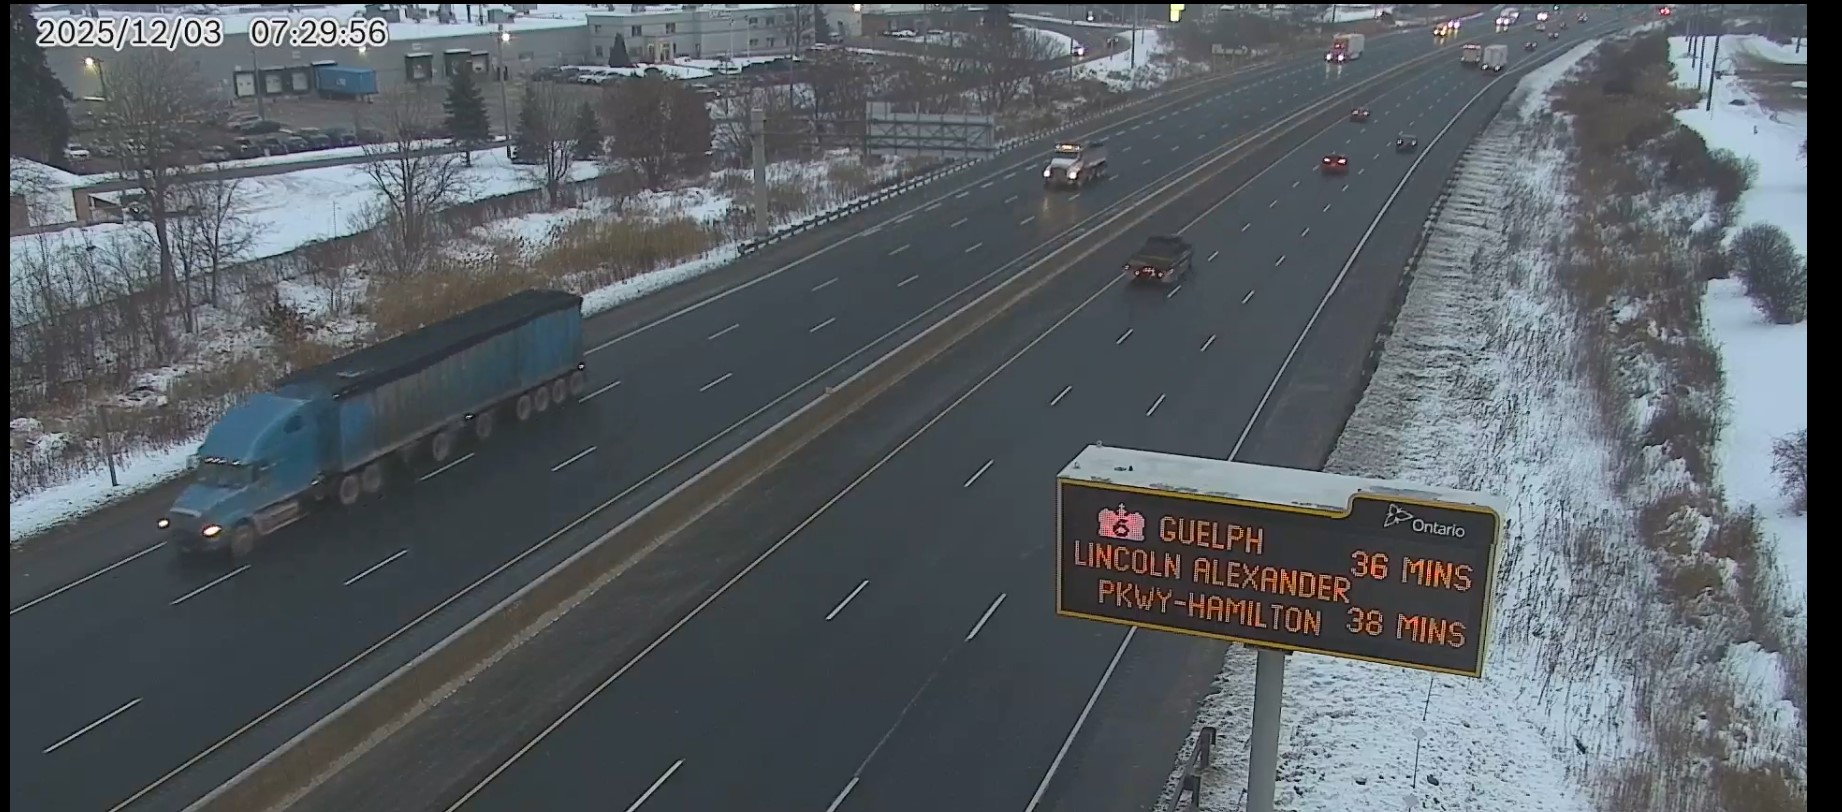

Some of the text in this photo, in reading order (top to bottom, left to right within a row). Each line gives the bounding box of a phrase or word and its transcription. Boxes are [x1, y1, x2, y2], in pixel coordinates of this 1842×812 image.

[1112, 519, 1129, 537] 6
[1159, 516, 1473, 592] GUELPH 36 MINS
[1411, 518, 1466, 538] Ontario
[1074, 541, 1350, 604] LINCOLN ALEXANDER
[1098, 580, 1466, 648] PKWY-HAMILTON 38 MINS
